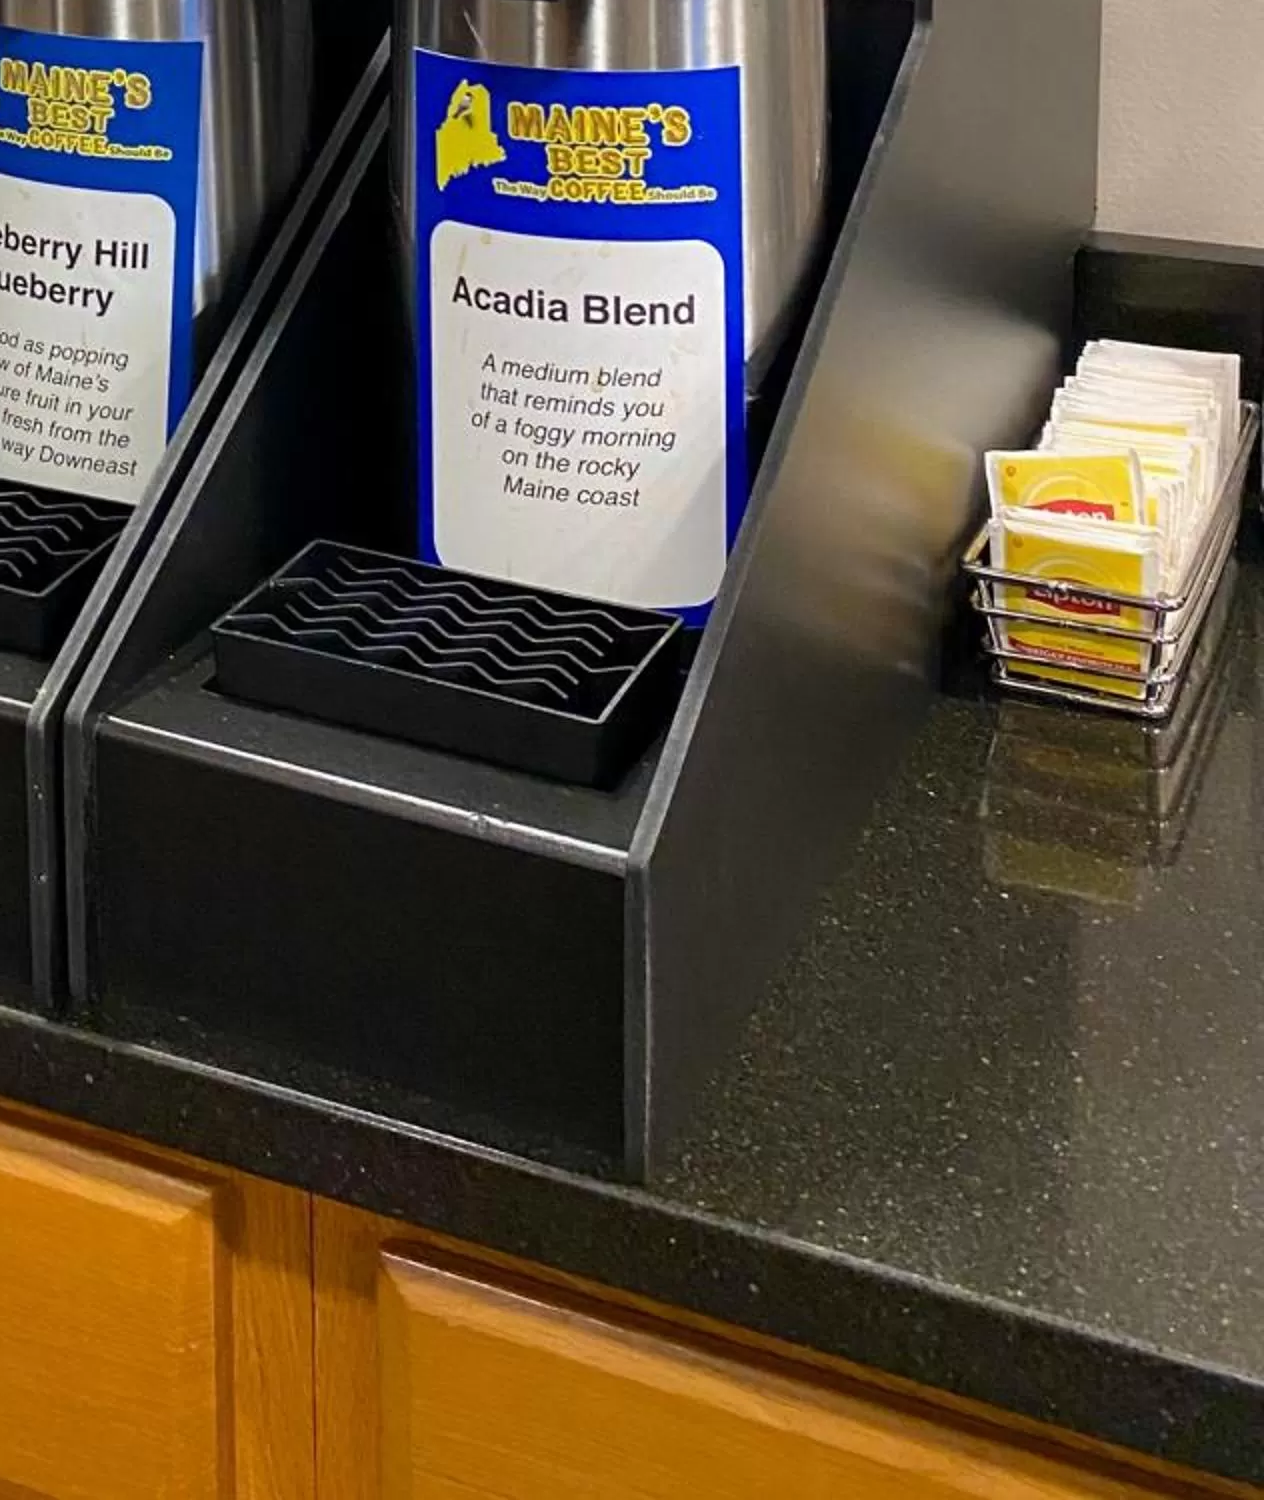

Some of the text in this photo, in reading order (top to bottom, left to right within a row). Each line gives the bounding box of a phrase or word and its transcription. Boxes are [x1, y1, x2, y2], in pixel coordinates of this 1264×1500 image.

[1, 57, 151, 108] MAINE'S
[29, 98, 114, 133] BEST
[509, 102, 691, 145] MAINE'S
[28, 128, 108, 155] COFFEE
[547, 145, 651, 177] BEST
[495, 180, 518, 195] The
[519, 183, 547, 199] Way
[549, 178, 645, 202] COFFEE
[95, 240, 149, 269] Hill
[452, 275, 695, 326] Acadia Blend
[23, 338, 45, 355] as
[48, 343, 129, 372] popping
[481, 353, 663, 388] A medium blend
[13, 361, 32, 378] of
[35, 364, 110, 393] Maine's
[25, 388, 59, 412] fruit
[64, 397, 82, 416] in
[87, 401, 134, 423] your
[480, 383, 664, 422] that reminds you
[1, 407, 43, 435] fresh
[48, 422, 92, 445] from
[98, 428, 131, 449] the
[471, 411, 676, 452] of a foggy morning
[1, 437, 35, 462] way
[39, 445, 138, 477] Downeast
[502, 449, 640, 483] on the rocky
[503, 475, 640, 507] Maine coast
